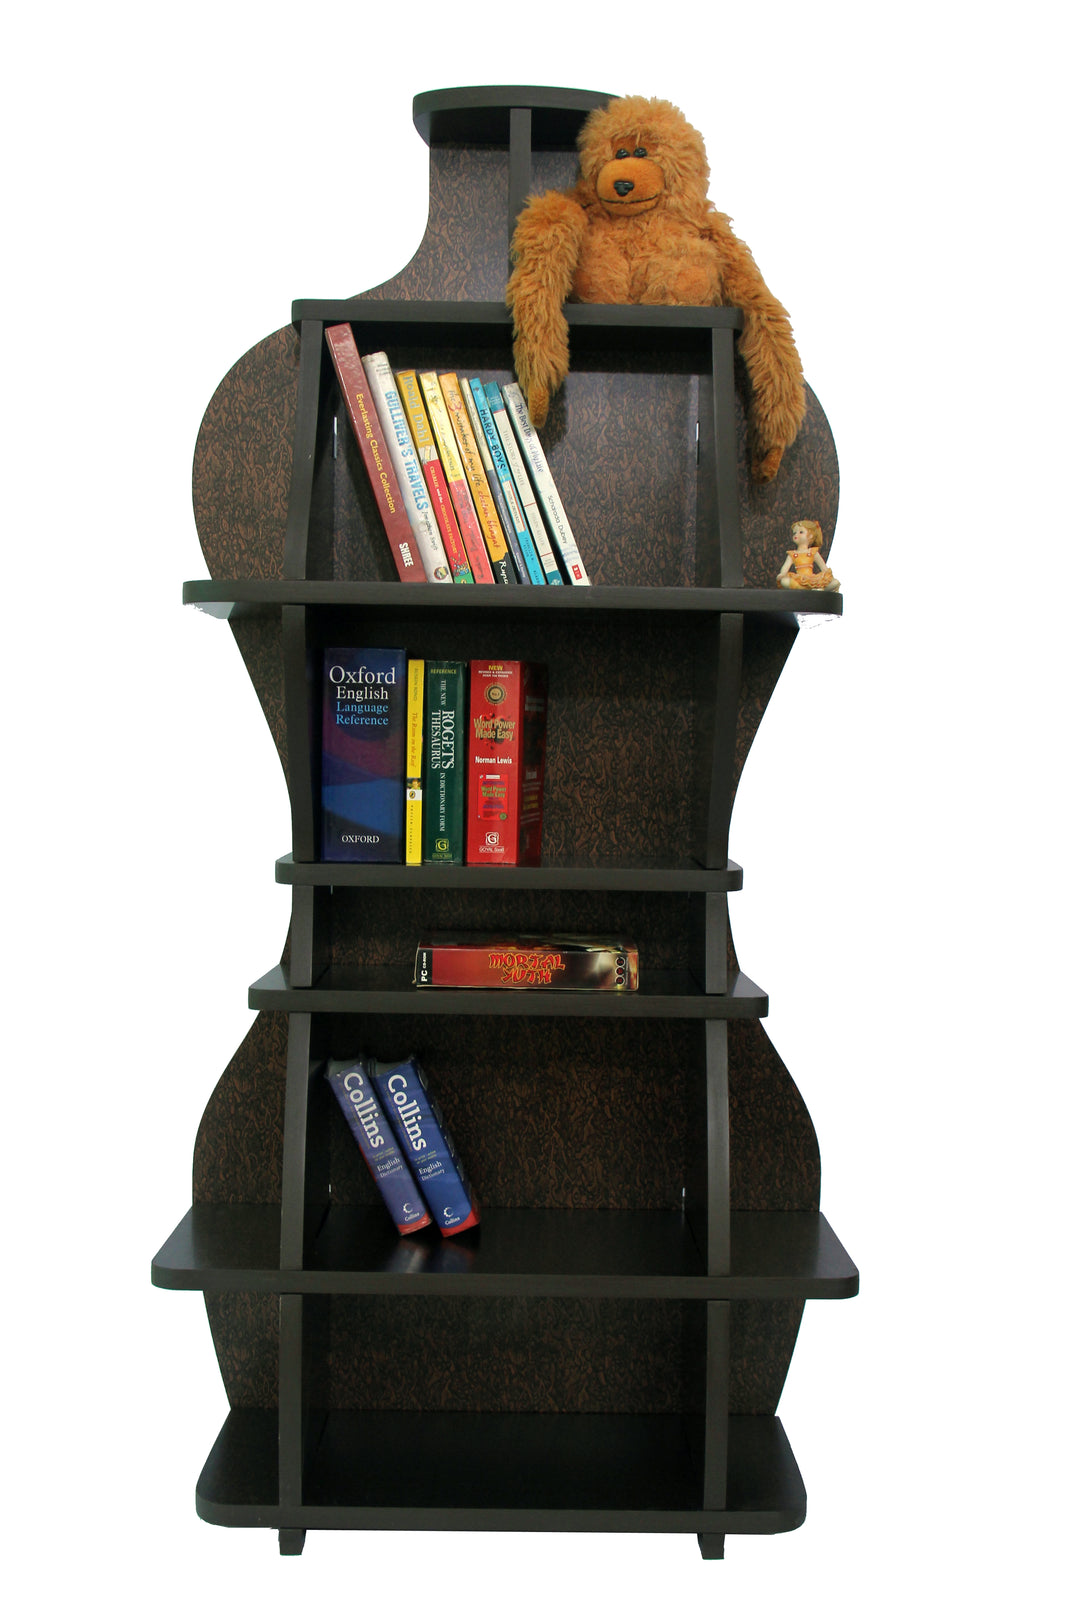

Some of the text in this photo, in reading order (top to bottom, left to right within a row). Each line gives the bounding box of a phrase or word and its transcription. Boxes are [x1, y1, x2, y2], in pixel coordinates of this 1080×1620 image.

[403, 376, 430, 442] Roald Dahl
[448, 401, 462, 412] 3
[515, 403, 523, 414] The
[519, 415, 529, 428] Best
[454, 413, 469, 447] mistakes
[480, 408, 506, 469] HARDY BOYS
[356, 394, 396, 513] Everlasting Classics Collection
[385, 391, 428, 510] GULLIVER'S TRAVELS
[508, 443, 516, 460] STORY
[466, 458, 475, 472] my
[473, 474, 484, 486] life
[430, 466, 438, 487] CHARLIE
[440, 504, 452, 532] CHOCOLATE
[448, 532, 458, 553] FACTORY
[479, 491, 500, 548] chetan bhagat
[558, 525, 567, 544] Dubey
[399, 542, 414, 567] SHREE
[329, 665, 396, 685] Oxford
[336, 686, 389, 702] English
[336, 702, 388, 714] Language
[336, 714, 389, 725] Reference
[474, 716, 515, 729] Word Power
[431, 710, 441, 769] THESAURUS
[441, 710, 454, 769] ROGET'S
[476, 728, 513, 741] Made Easy
[342, 835, 380, 843] OXFORD
[488, 953, 565, 970] MORTAL
[421, 969, 427, 982] PC
[344, 1072, 384, 1148] Collins
[388, 1074, 426, 1150] Collins
[377, 1157, 400, 1172] English
[380, 1165, 403, 1178] Dictionary
[419, 1161, 442, 1175] English
[422, 1169, 445, 1181] Dictionary
[405, 1212, 419, 1221] Collins
[445, 1217, 460, 1225] Collins
